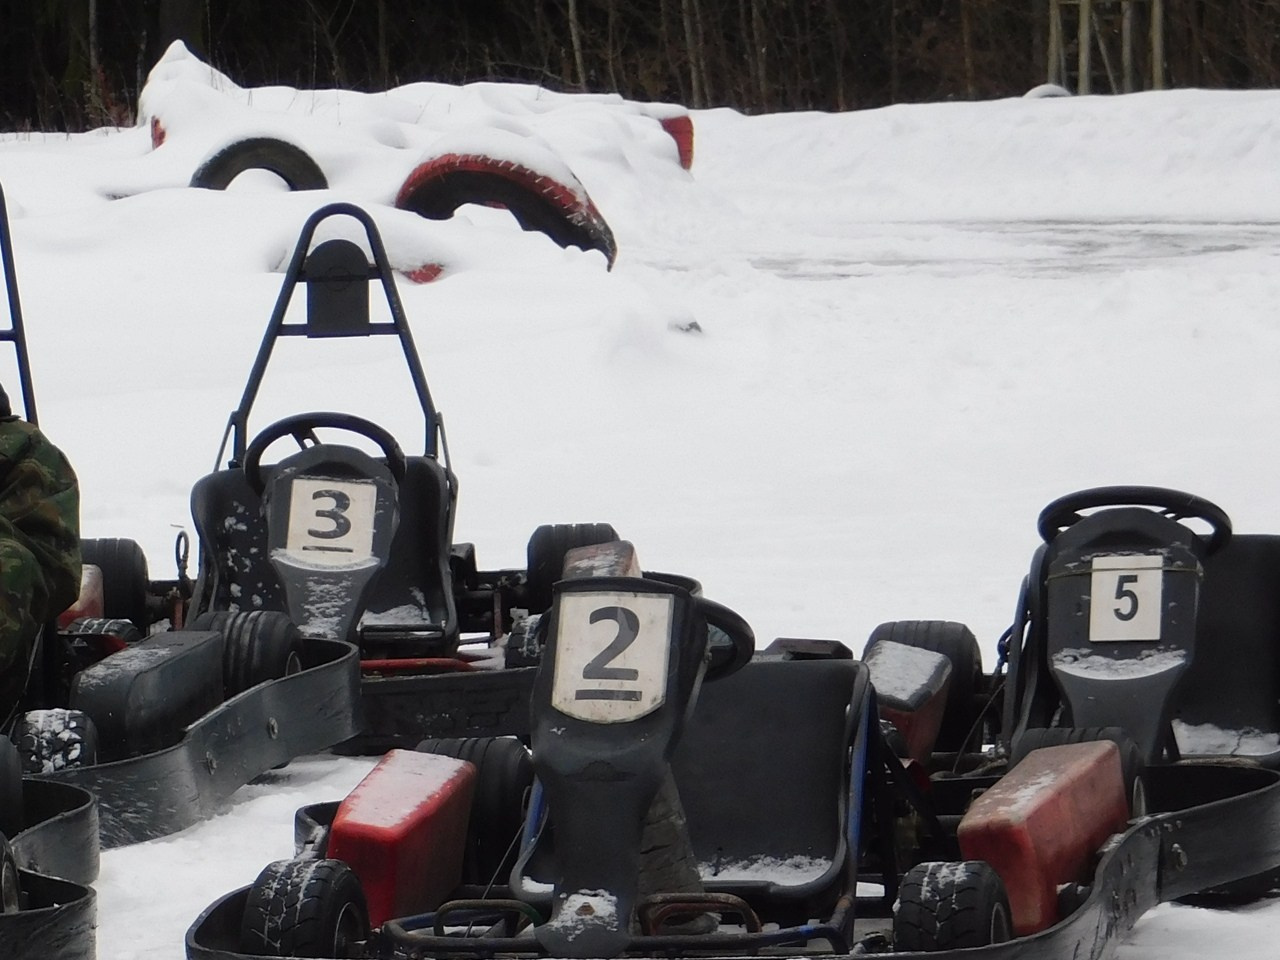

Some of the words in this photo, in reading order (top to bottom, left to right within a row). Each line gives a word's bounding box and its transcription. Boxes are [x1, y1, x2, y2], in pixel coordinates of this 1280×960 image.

[307, 489, 352, 540] 3
[1113, 574, 1139, 622] 5
[582, 606, 641, 681] 2
